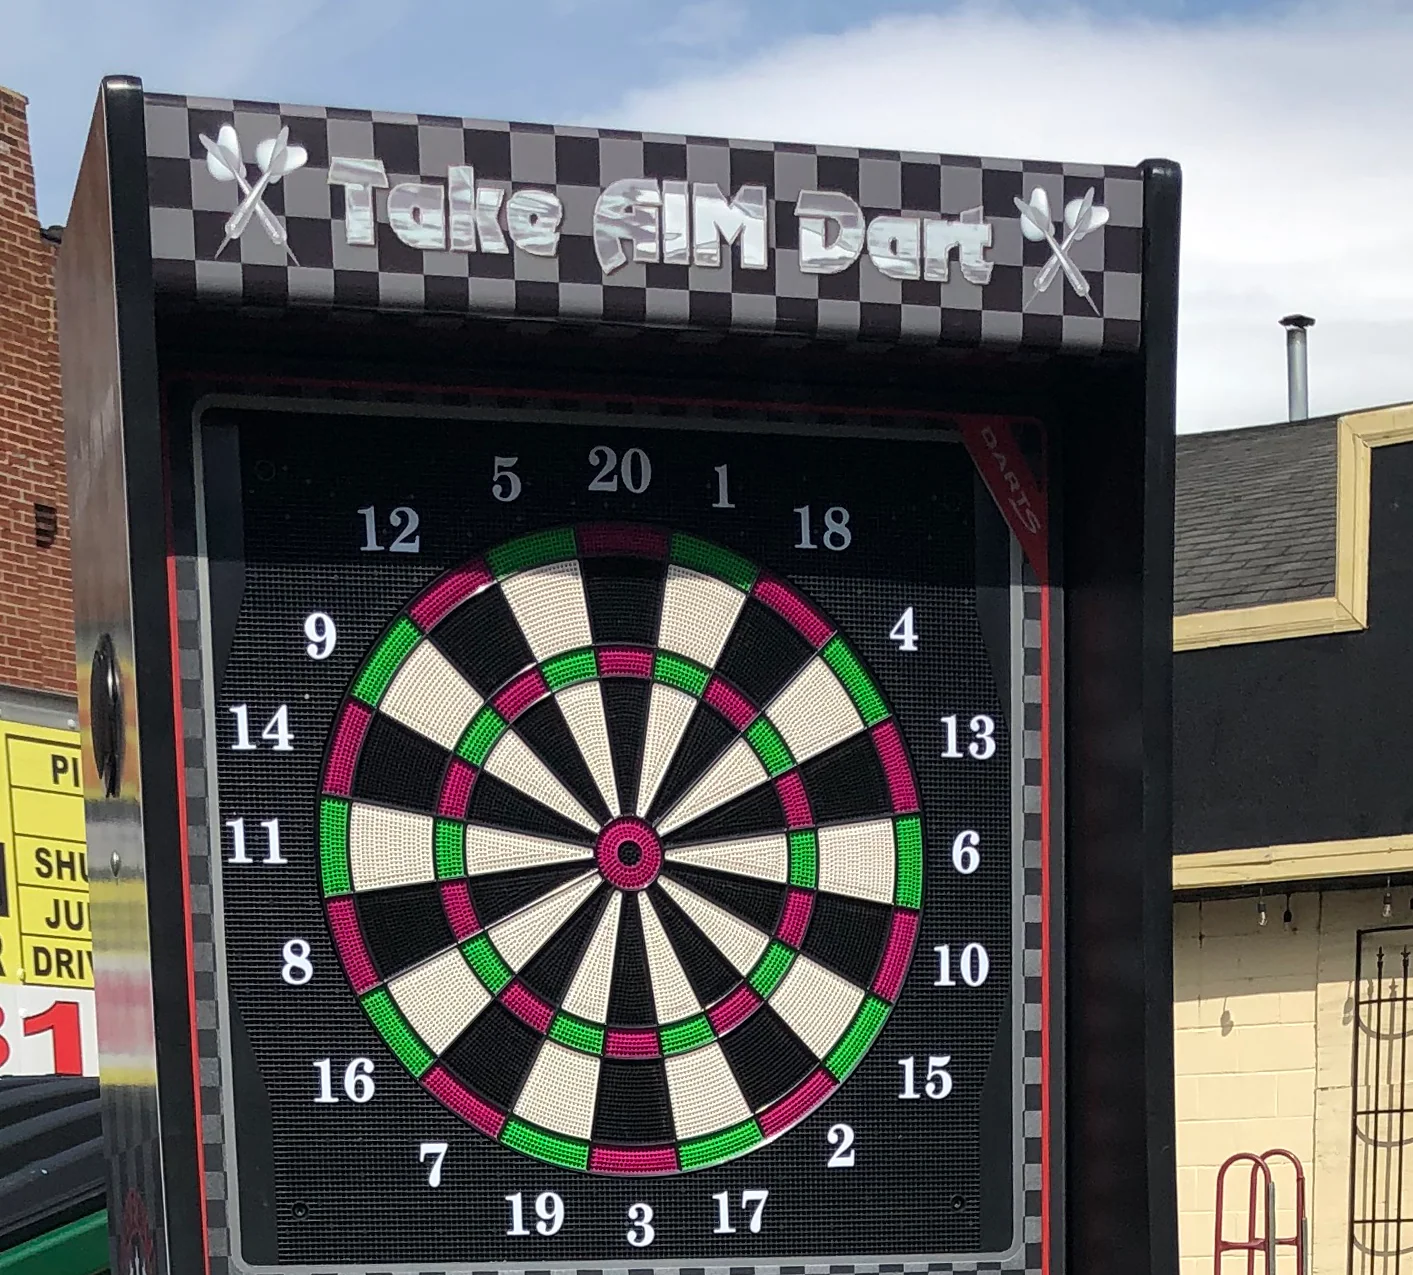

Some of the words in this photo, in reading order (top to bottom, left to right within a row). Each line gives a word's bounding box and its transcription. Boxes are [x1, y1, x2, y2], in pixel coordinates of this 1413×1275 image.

[327, 156, 563, 257] Take
[593, 178, 768, 276] AIM
[794, 189, 995, 285] Dart
[492, 456, 522, 502] 5
[589, 446, 652, 494] 20
[712, 464, 735, 508] 1
[981, 425, 1041, 535] DARTS
[357, 506, 421, 553] 12
[793, 505, 852, 551] 18
[304, 612, 336, 660] 9
[889, 606, 918, 651] 4
[229, 703, 294, 751] 14
[940, 714, 996, 760] 13
[227, 818, 288, 865] 11
[952, 830, 980, 874] 6
[281, 938, 314, 985] 8
[933, 943, 990, 987] 10
[312, 1057, 376, 1103] 16
[898, 1055, 953, 1100] 15
[419, 1142, 449, 1188] 7
[827, 1123, 855, 1168] 2
[505, 1191, 565, 1236] 19
[626, 1202, 655, 1247] 3
[712, 1189, 769, 1234] 17
